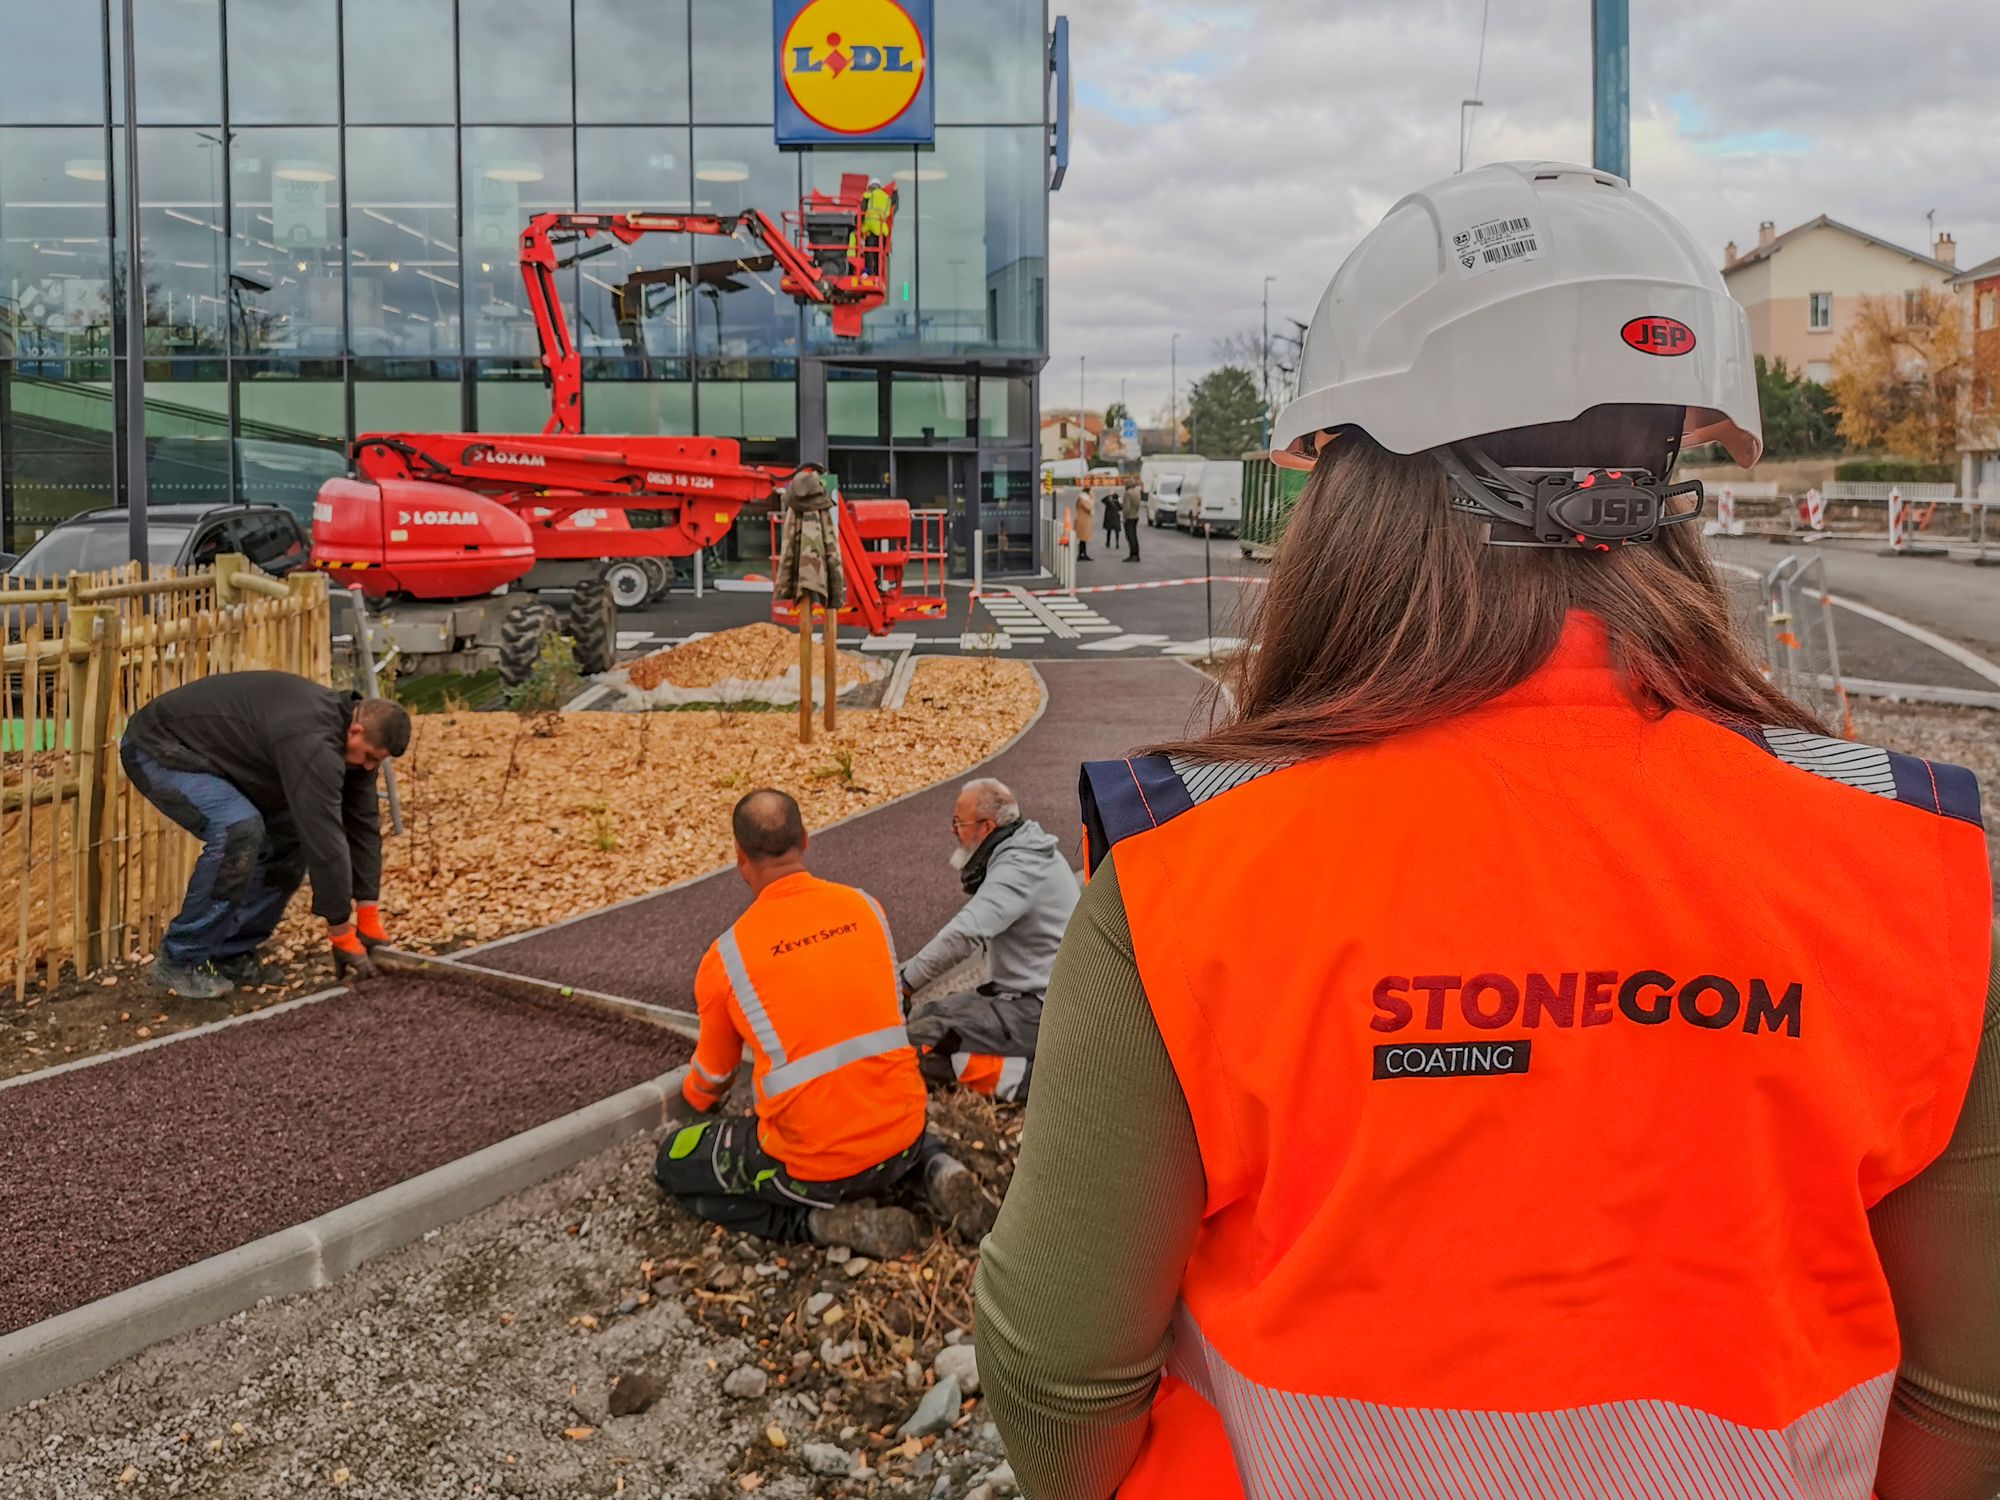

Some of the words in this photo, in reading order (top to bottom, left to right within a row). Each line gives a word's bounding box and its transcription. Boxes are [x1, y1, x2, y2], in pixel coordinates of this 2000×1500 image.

[1635, 324, 1686, 347] JSP
[486, 451, 545, 466] LOXAM
[690, 477, 714, 489] 1234
[413, 511, 479, 526] LOXAM
[1580, 498, 1651, 526] JSP
[1369, 970, 1802, 1038] STONEGOM
[1386, 1046, 1514, 1073] COATING
